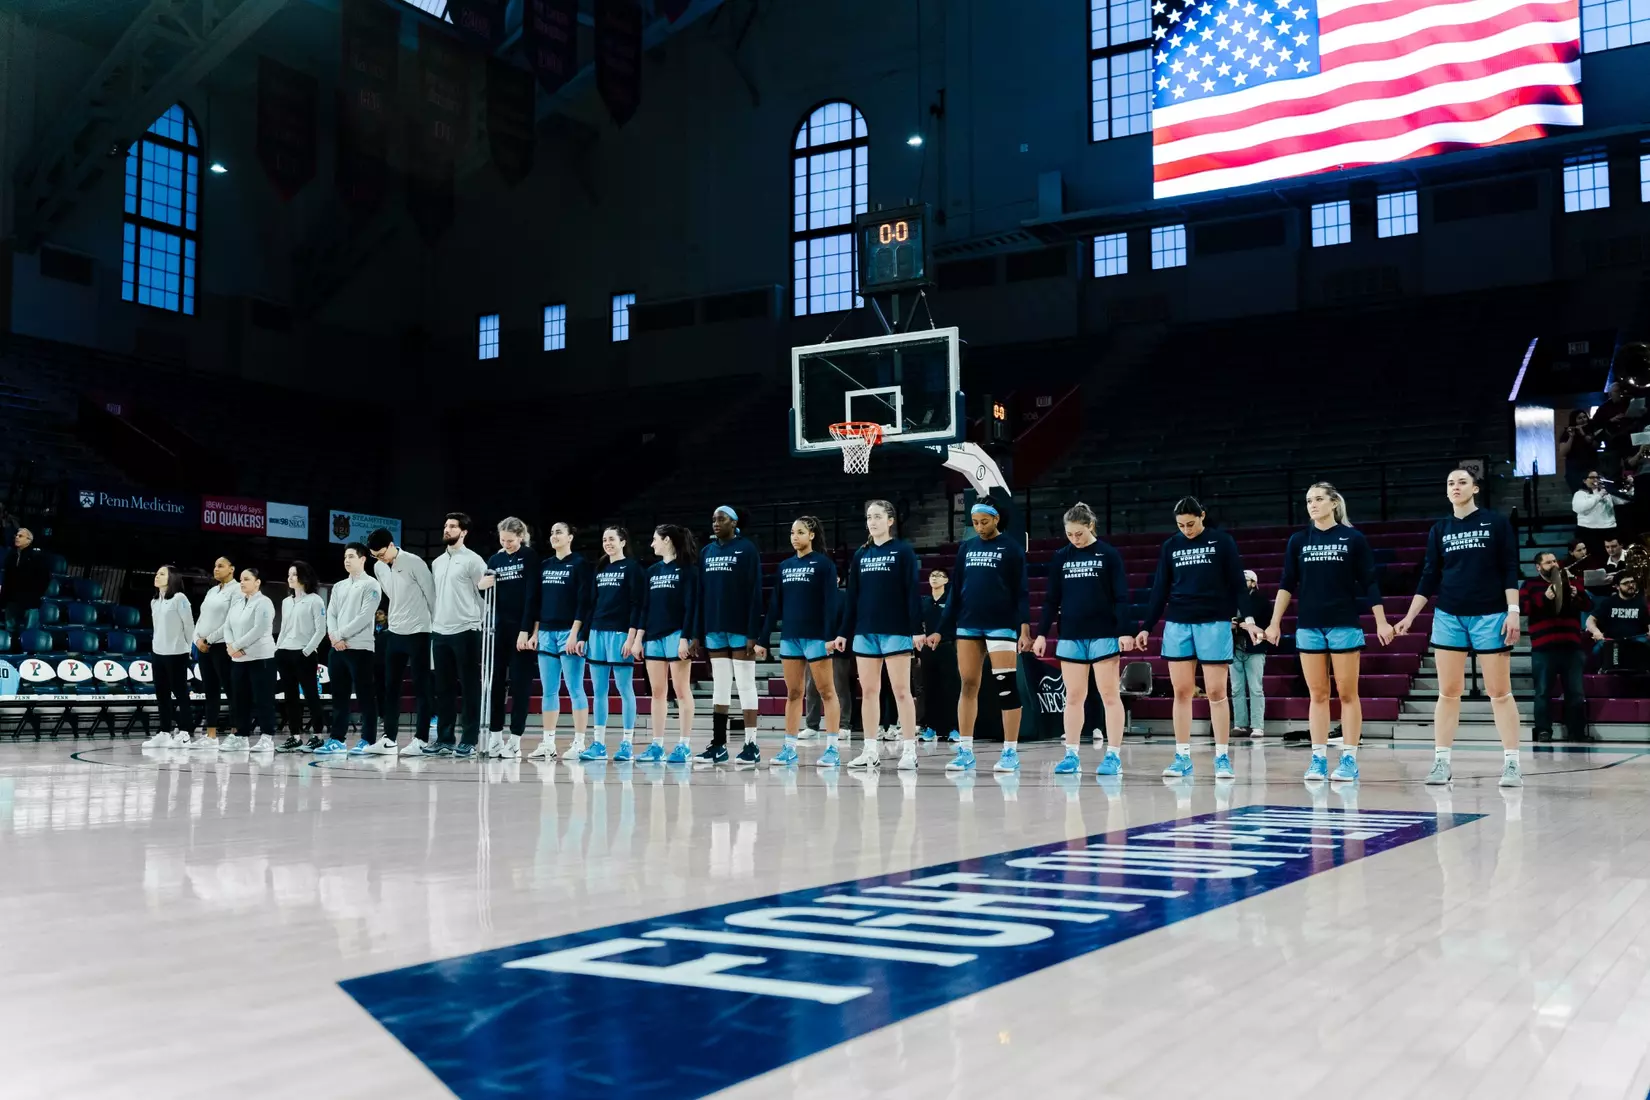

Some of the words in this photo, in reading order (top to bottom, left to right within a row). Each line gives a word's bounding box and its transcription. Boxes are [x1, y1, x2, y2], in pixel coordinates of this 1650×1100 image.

[99, 491, 129, 508] Penn
[131, 495, 185, 513] Medicine
[205, 500, 222, 509] IBEW
[223, 502, 239, 511] Local
[240, 504, 248, 512] 98
[204, 509, 217, 524] GO
[219, 511, 265, 529] QUAKERS!
[1442, 530, 1490, 542] COLUMBIA
[1172, 546, 1216, 557] COLUMBIA
[1302, 544, 1348, 552] COLUMBIA
[1445, 543, 1486, 552] BASKETBALL
[1175, 559, 1212, 567] BASKETBALL
[1610, 607, 1639, 619] PENN
[1128, 809, 1438, 850] PENN
[1005, 843, 1310, 879] ON
[502, 872, 1188, 1005] FIGHT
